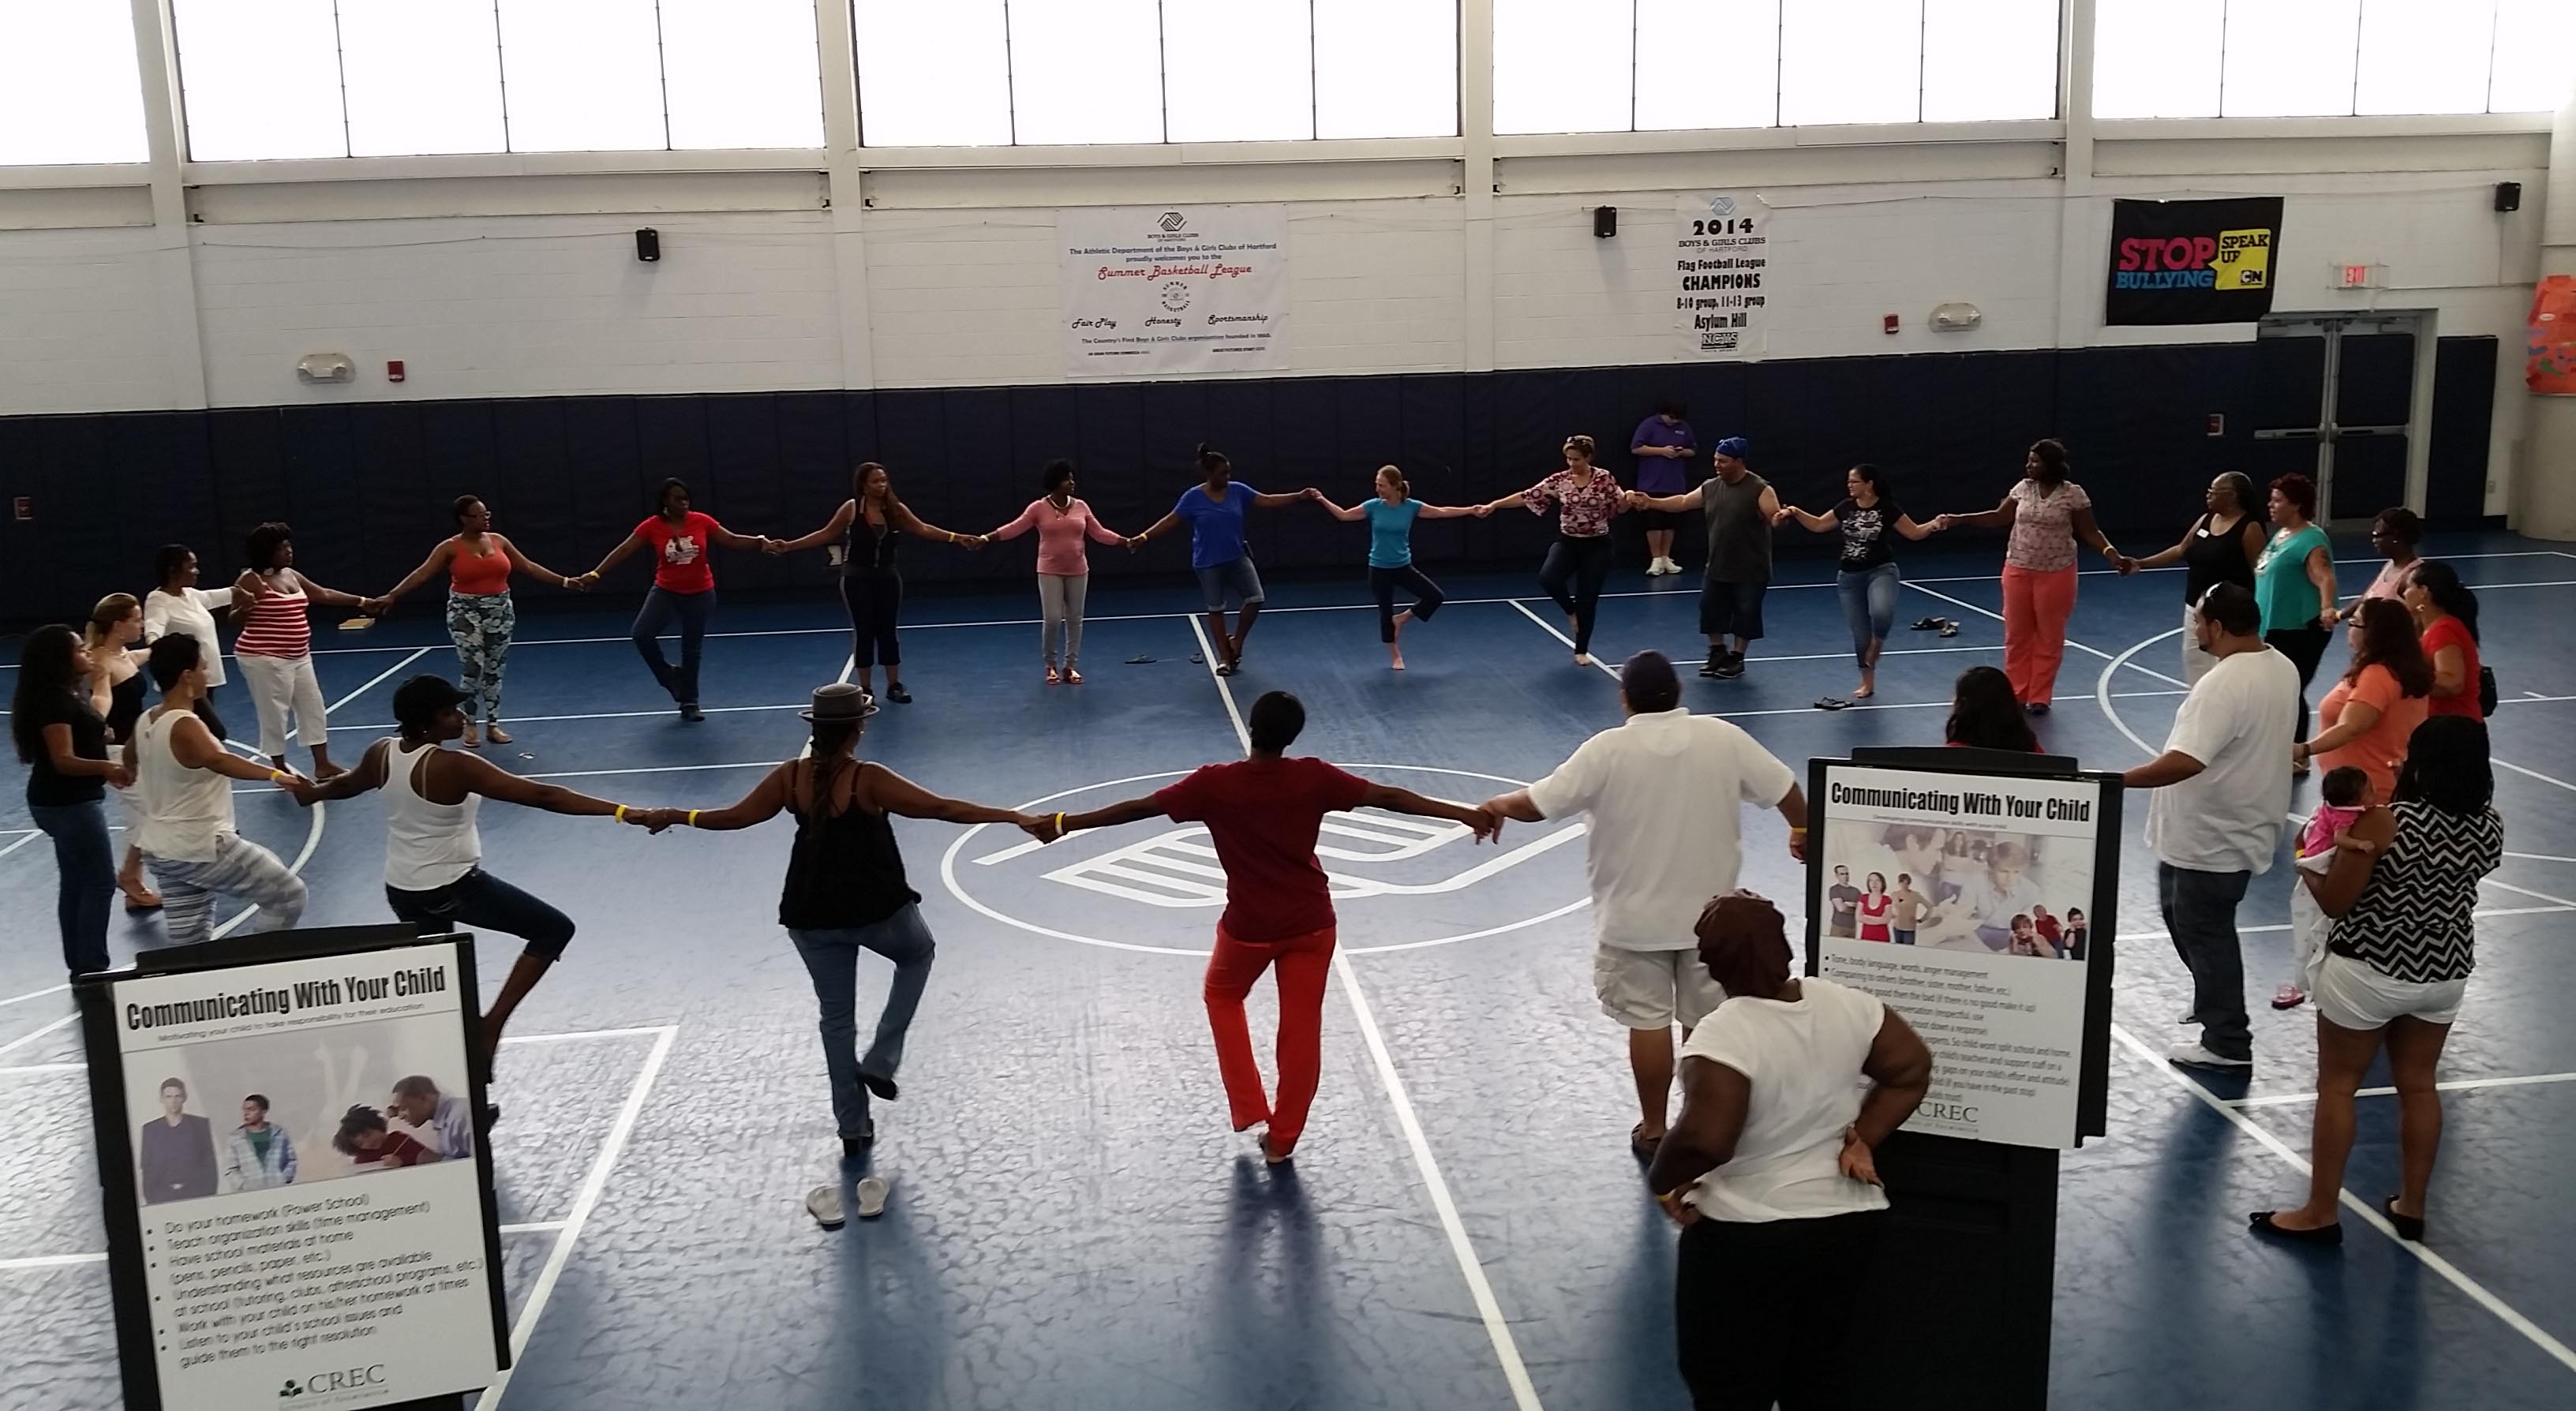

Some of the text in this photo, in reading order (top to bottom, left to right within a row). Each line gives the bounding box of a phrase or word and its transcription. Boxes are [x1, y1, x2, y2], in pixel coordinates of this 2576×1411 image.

[1693, 218, 1754, 236] 2014
[2222, 234, 2269, 249] SPEAK
[1678, 258, 1766, 271] Flag Football League
[2119, 238, 2215, 271] STOP
[2221, 250, 2241, 263] UP
[1098, 263, 1252, 281] Summer Basketball League
[1683, 273, 1761, 291] CHAMPIONS
[2115, 270, 2215, 289] BULLYING
[2241, 271, 2263, 285] CN
[1677, 297, 1694, 309] 8-10
[1721, 295, 1742, 308] 11-13
[1744, 296, 1765, 309] group
[1072, 317, 1118, 329] Fair Play
[1145, 316, 1182, 327] Honesty
[1208, 314, 1269, 325] Sportsmanship
[1694, 312, 1747, 332] Asylum Hill
[1832, 783, 2090, 822] Communicating With Your Child
[127, 966, 445, 1028] Communicating With Your Child
[1917, 1101, 1979, 1123] CREC
[164, 1193, 369, 1234] Do your homework (Power School)
[167, 1236, 206, 1249] Teach
[208, 1225, 283, 1245] organization
[285, 1219, 310, 1233] skills
[345, 1201, 429, 1222] management)
[168, 1231, 354, 1266] Have school materials at home
[173, 1251, 432, 1300] Understanding what resources are available
[173, 1304, 187, 1317] at
[189, 1298, 230, 1315] school
[327, 1273, 393, 1293] afterschool
[178, 1319, 208, 1332] Work
[212, 1315, 236, 1327] with
[238, 1311, 265, 1326] your
[268, 1304, 298, 1318] child
[299, 1303, 316, 1313] on
[359, 1285, 421, 1303] homework
[422, 1282, 436, 1293] at
[438, 1278, 469, 1290] times
[178, 1336, 214, 1349] Listen
[215, 1333, 230, 1343] to
[232, 1328, 258, 1343] your
[301, 1313, 341, 1330] school
[377, 1303, 402, 1317] and
[179, 1326, 376, 1368] guide them to the right resolution
[307, 1364, 384, 1393] CREC
